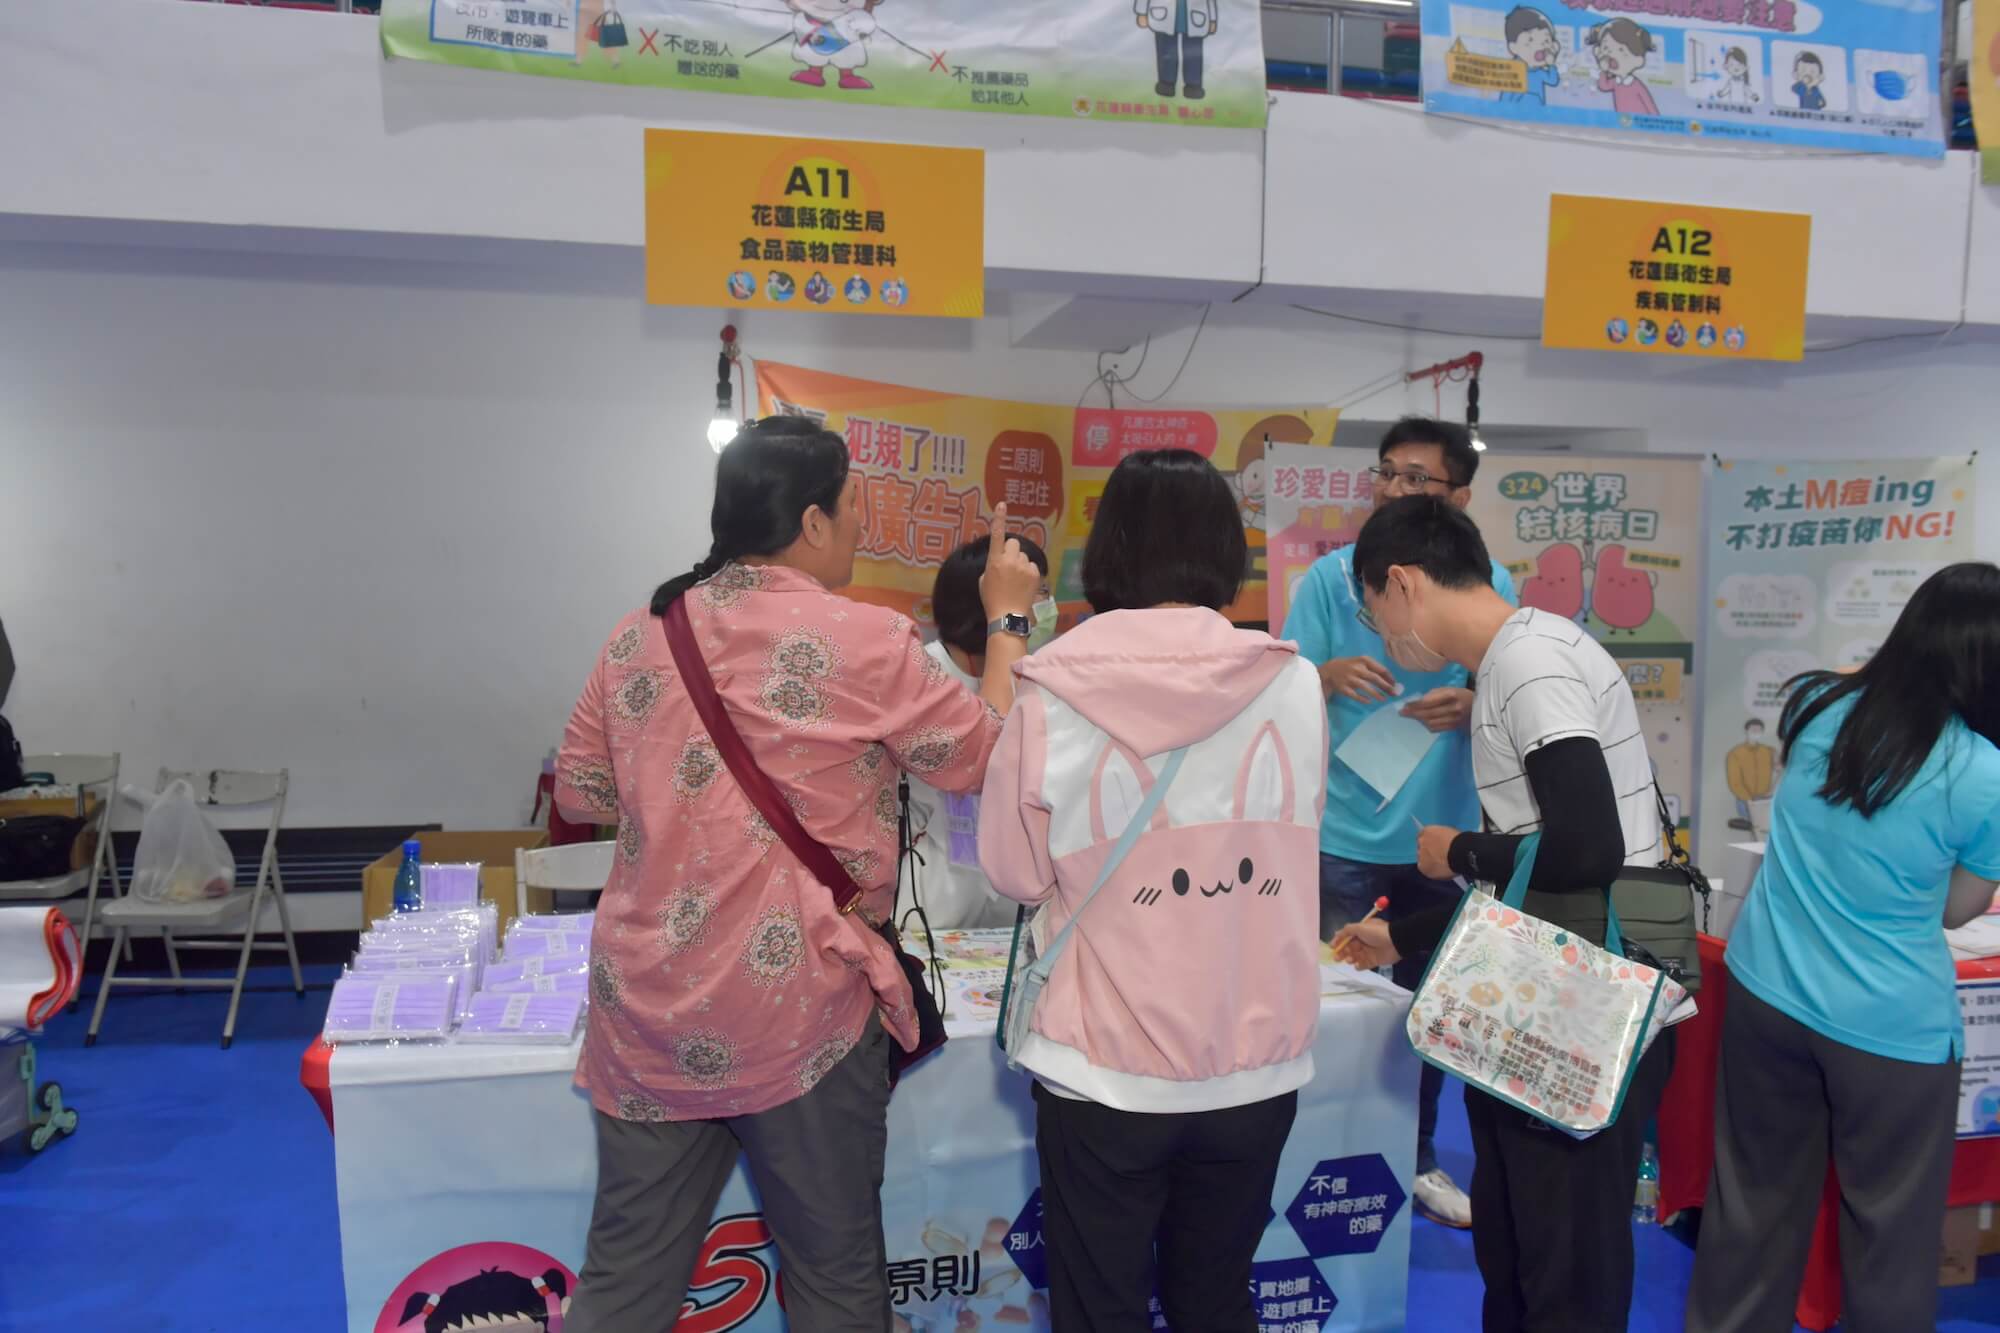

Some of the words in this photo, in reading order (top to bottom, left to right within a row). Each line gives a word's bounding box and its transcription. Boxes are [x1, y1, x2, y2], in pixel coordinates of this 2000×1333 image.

[664, 33, 733, 57] 不吃別人
[971, 89, 1030, 106] 給其他人
[784, 166, 850, 198] A11
[751, 204, 885, 232] 花蓮縣衛生局
[740, 237, 896, 267] 食品藥物管理科
[1651, 227, 1712, 256] A12
[1629, 260, 1732, 286] 花蓮縣衛生局
[1635, 291, 1721, 314] 疾病管制科
[1087, 424, 1110, 449] 停
[998, 447, 1044, 474] 三原則
[1004, 480, 1049, 507] 要記住
[1505, 478, 1543, 495] 324
[1553, 473, 1625, 506] 世界
[1518, 507, 1657, 542] 結核病日
[1726, 511, 1957, 551] 不打疫苗你NG!
[1309, 1175, 1348, 1196] 不信
[1304, 1194, 1388, 1220] 有神奇療效
[1349, 1214, 1383, 1235] 的藥
[1010, 1231, 1045, 1251] 別人
[886, 1250, 980, 1306] 原則
